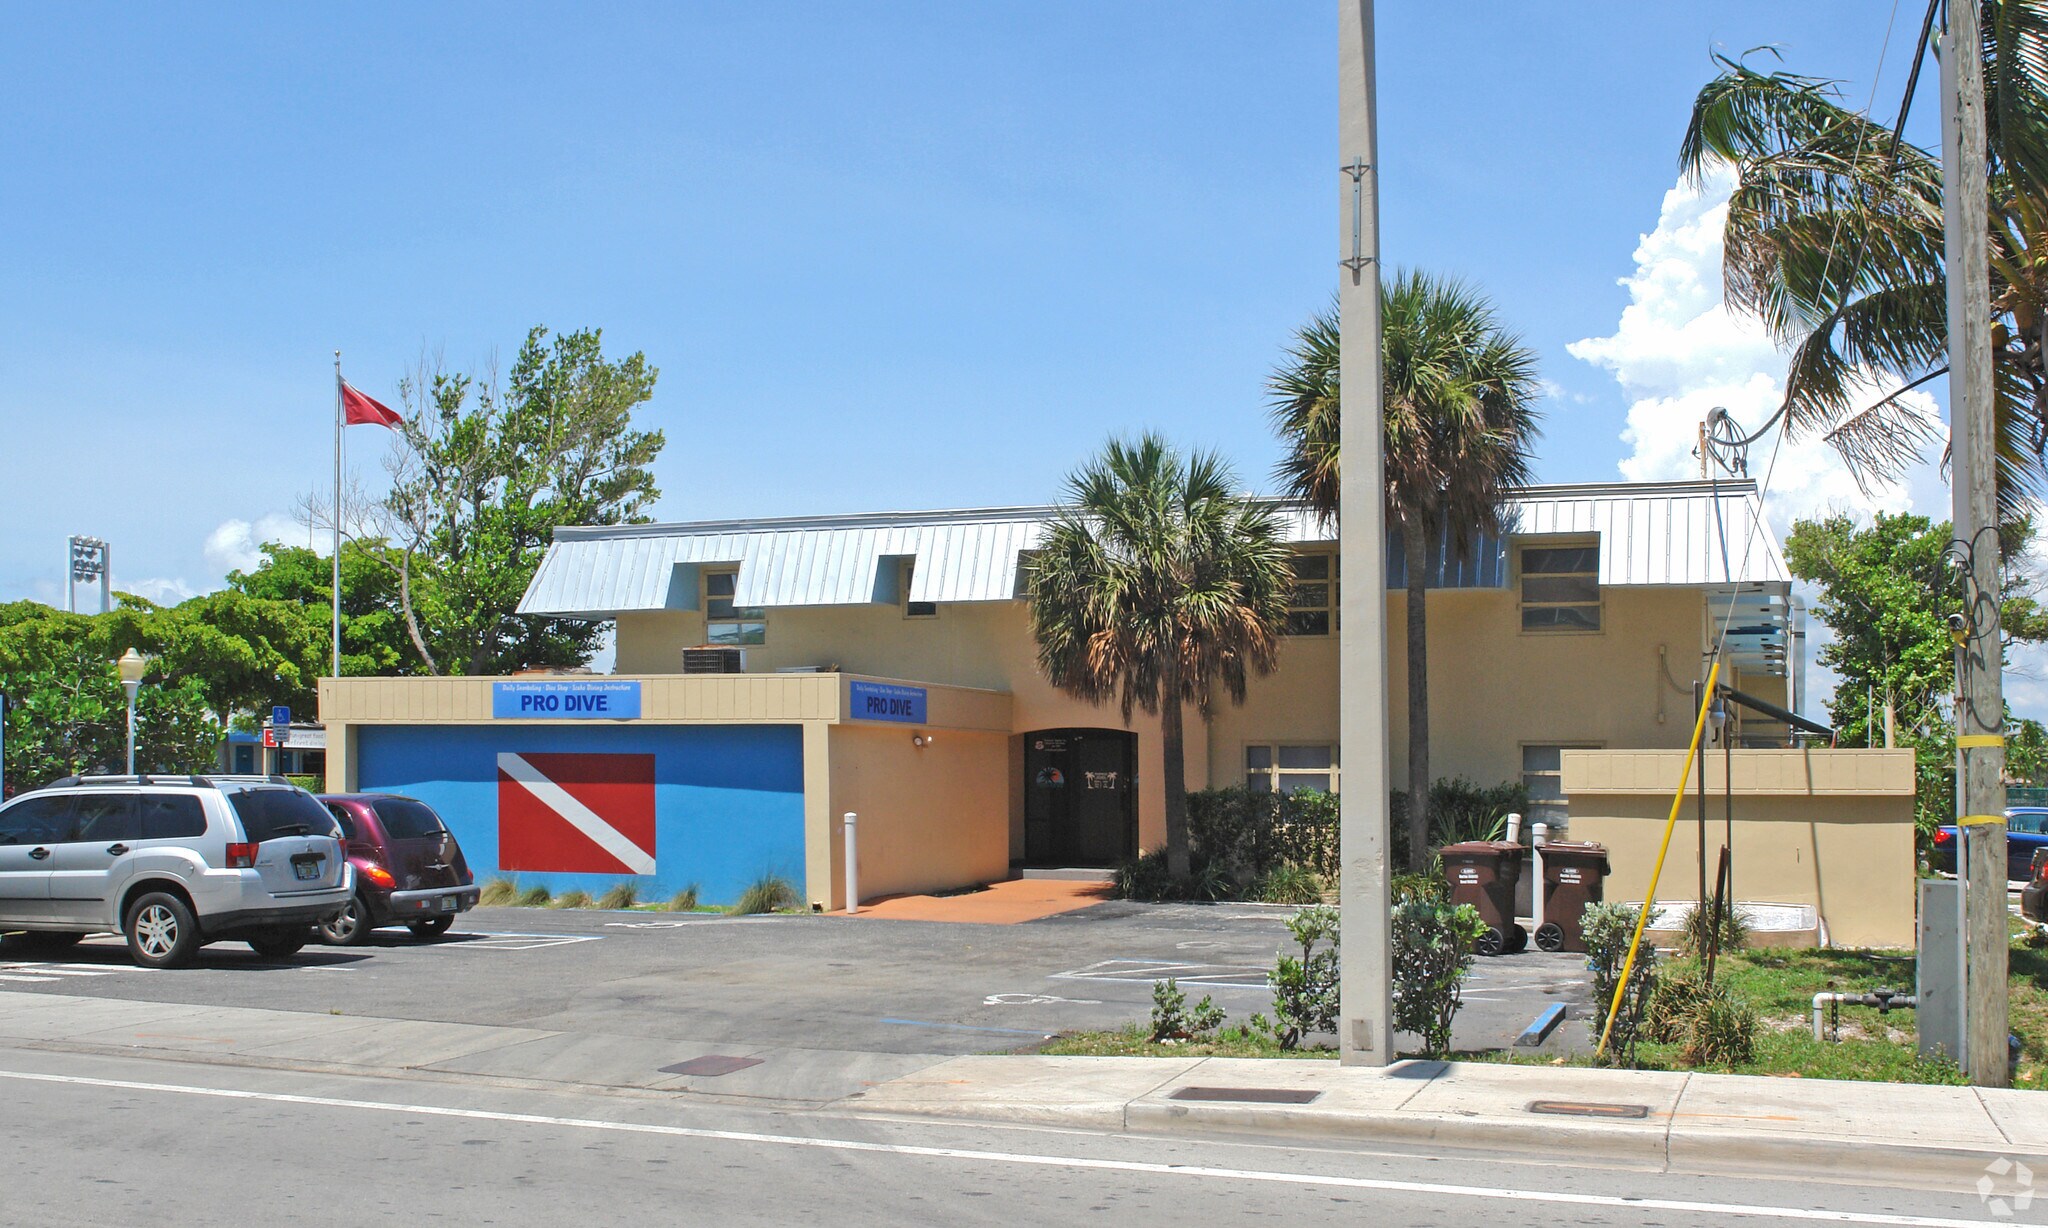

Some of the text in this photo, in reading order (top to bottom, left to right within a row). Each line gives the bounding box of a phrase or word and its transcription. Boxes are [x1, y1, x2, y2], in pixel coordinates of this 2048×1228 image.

[502, 684, 515, 692] Daily
[557, 684, 569, 692] Shop
[521, 695, 607, 711] PRO DIVE
[867, 697, 912, 716] PRO DIVE
